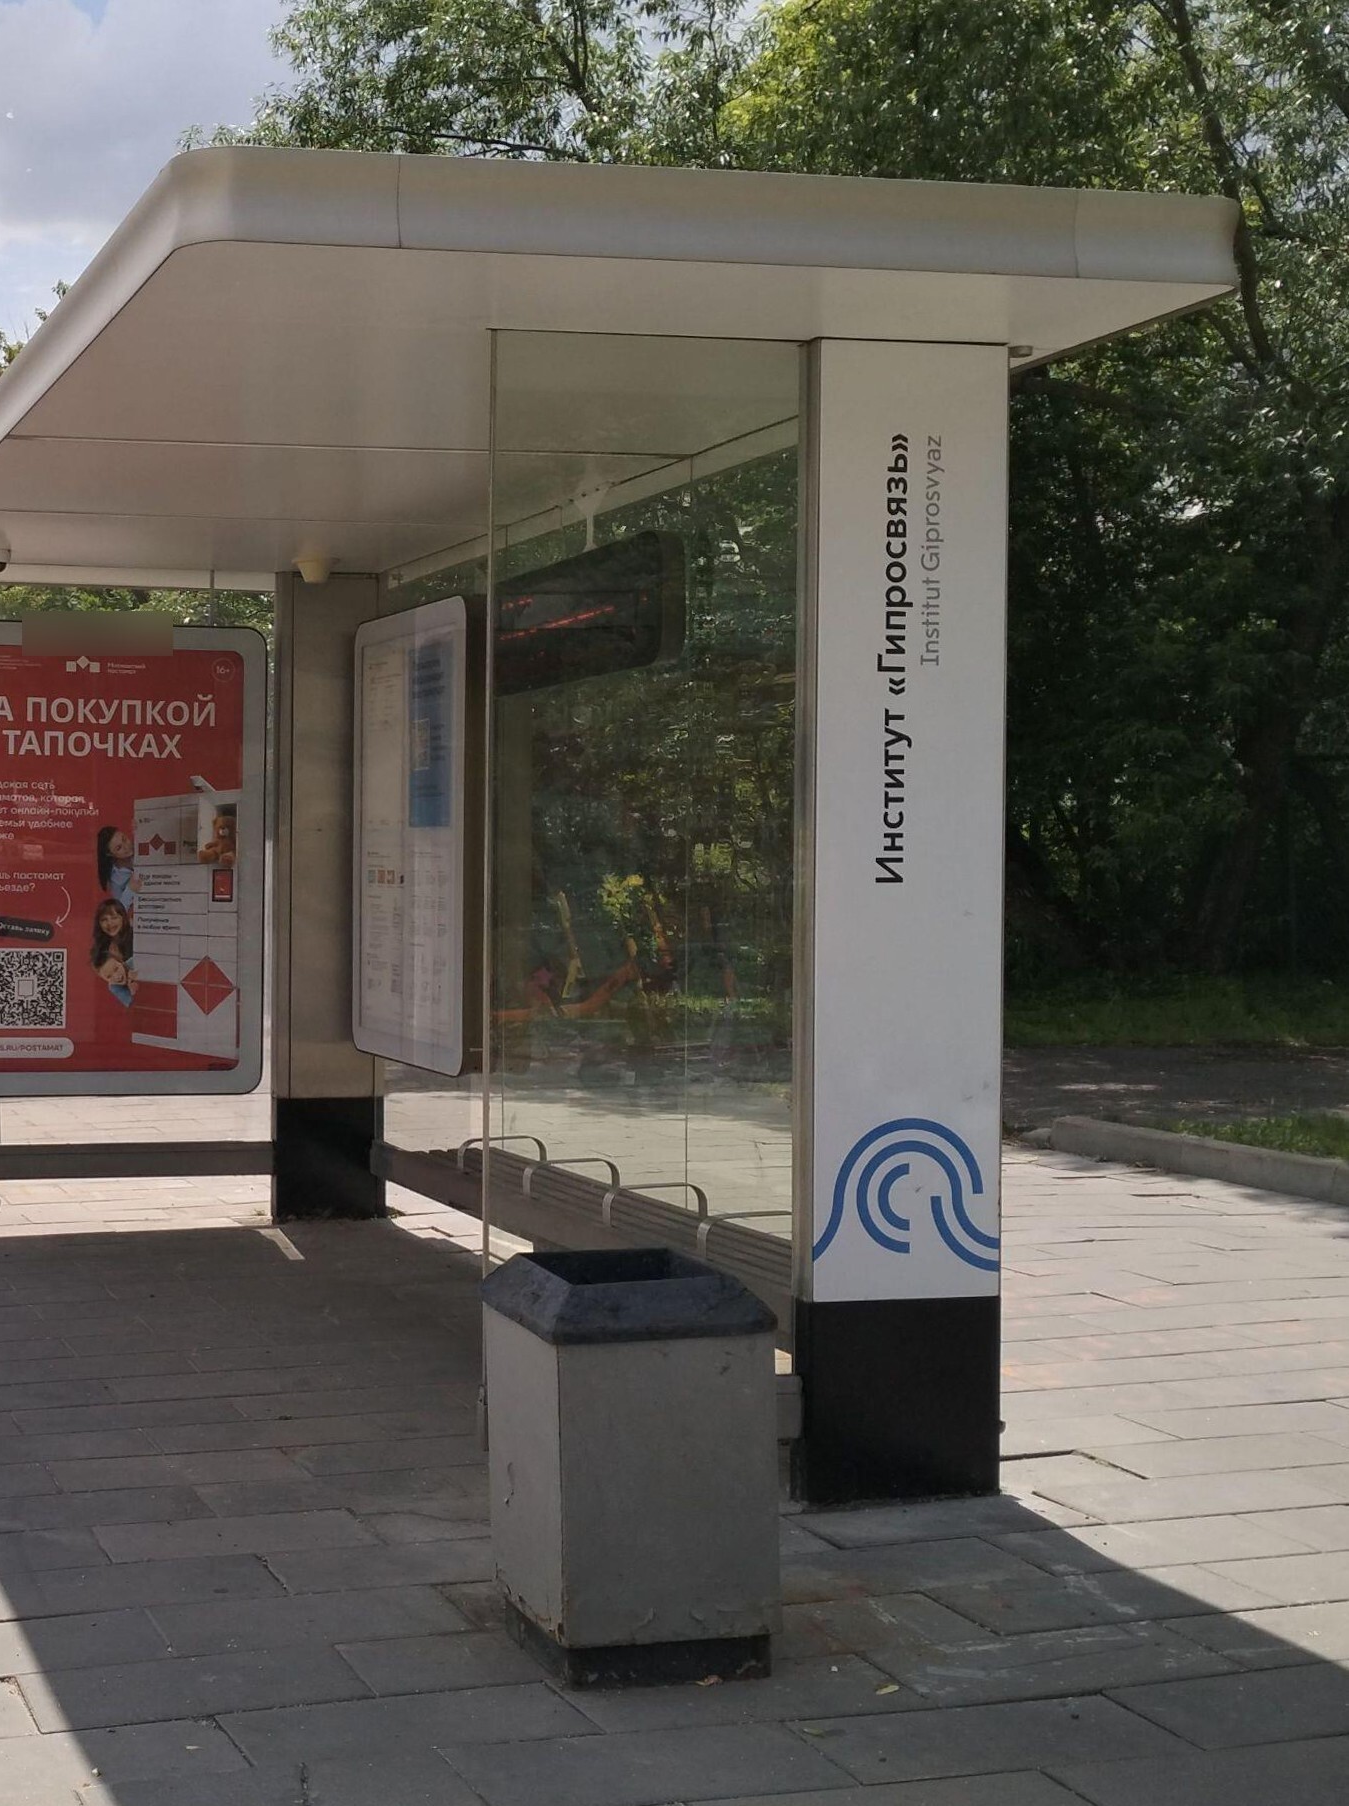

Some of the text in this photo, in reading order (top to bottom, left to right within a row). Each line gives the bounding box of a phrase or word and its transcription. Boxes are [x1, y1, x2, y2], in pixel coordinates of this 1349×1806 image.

[920, 435, 944, 666] Institut Giprosvyaz
[875, 433, 913, 883] Институт «Гипросвязь»
[27, 693, 216, 727] ПОКУПКОЙ
[3, 730, 182, 758] ТАПОЧКАХ
[31, 780, 55, 790] сеть
[10, 806, 99, 818] онлайн-покупки
[28, 819, 73, 830] удобнее
[13, 872, 65, 880] постамат
